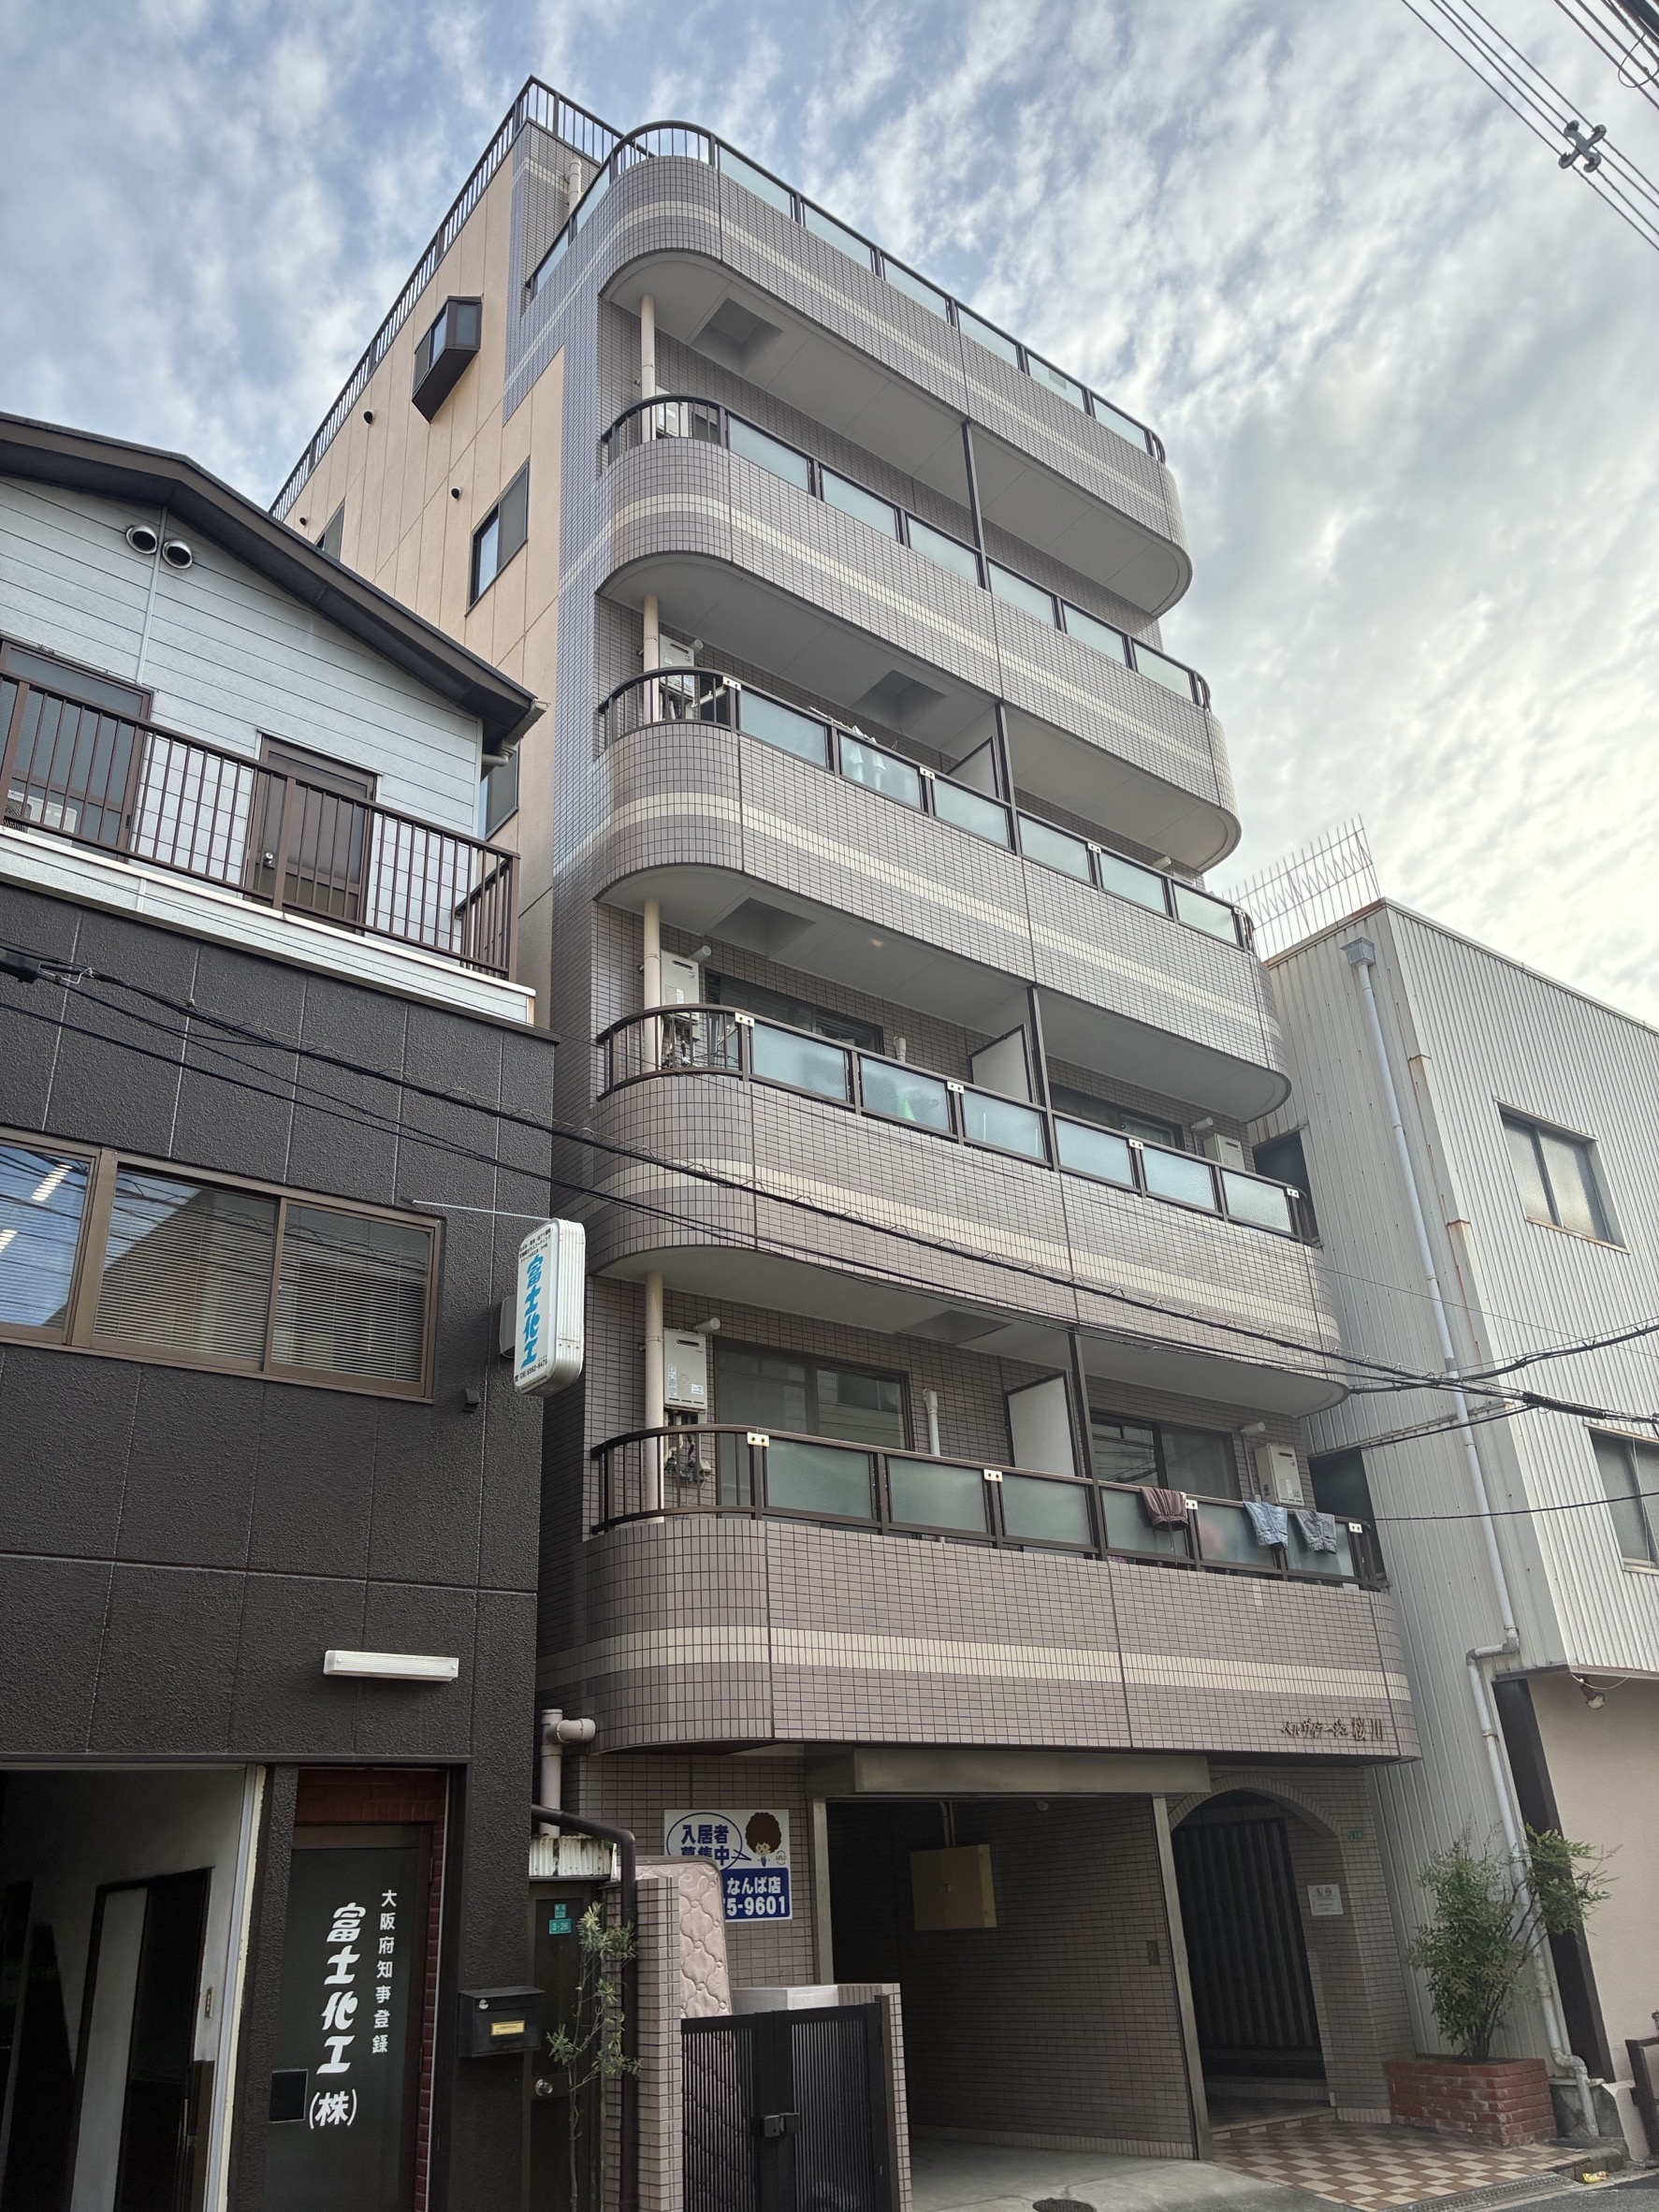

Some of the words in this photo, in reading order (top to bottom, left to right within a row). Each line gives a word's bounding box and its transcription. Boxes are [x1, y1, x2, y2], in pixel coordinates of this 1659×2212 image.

[521, 1254, 544, 1369] 富士化工
[681, 1824, 729, 1844] 入居者
[727, 1876, 781, 1895] なんば店
[723, 1896, 785, 1916] 5-9601
[372, 1889, 398, 2054] 大阪府知事登録
